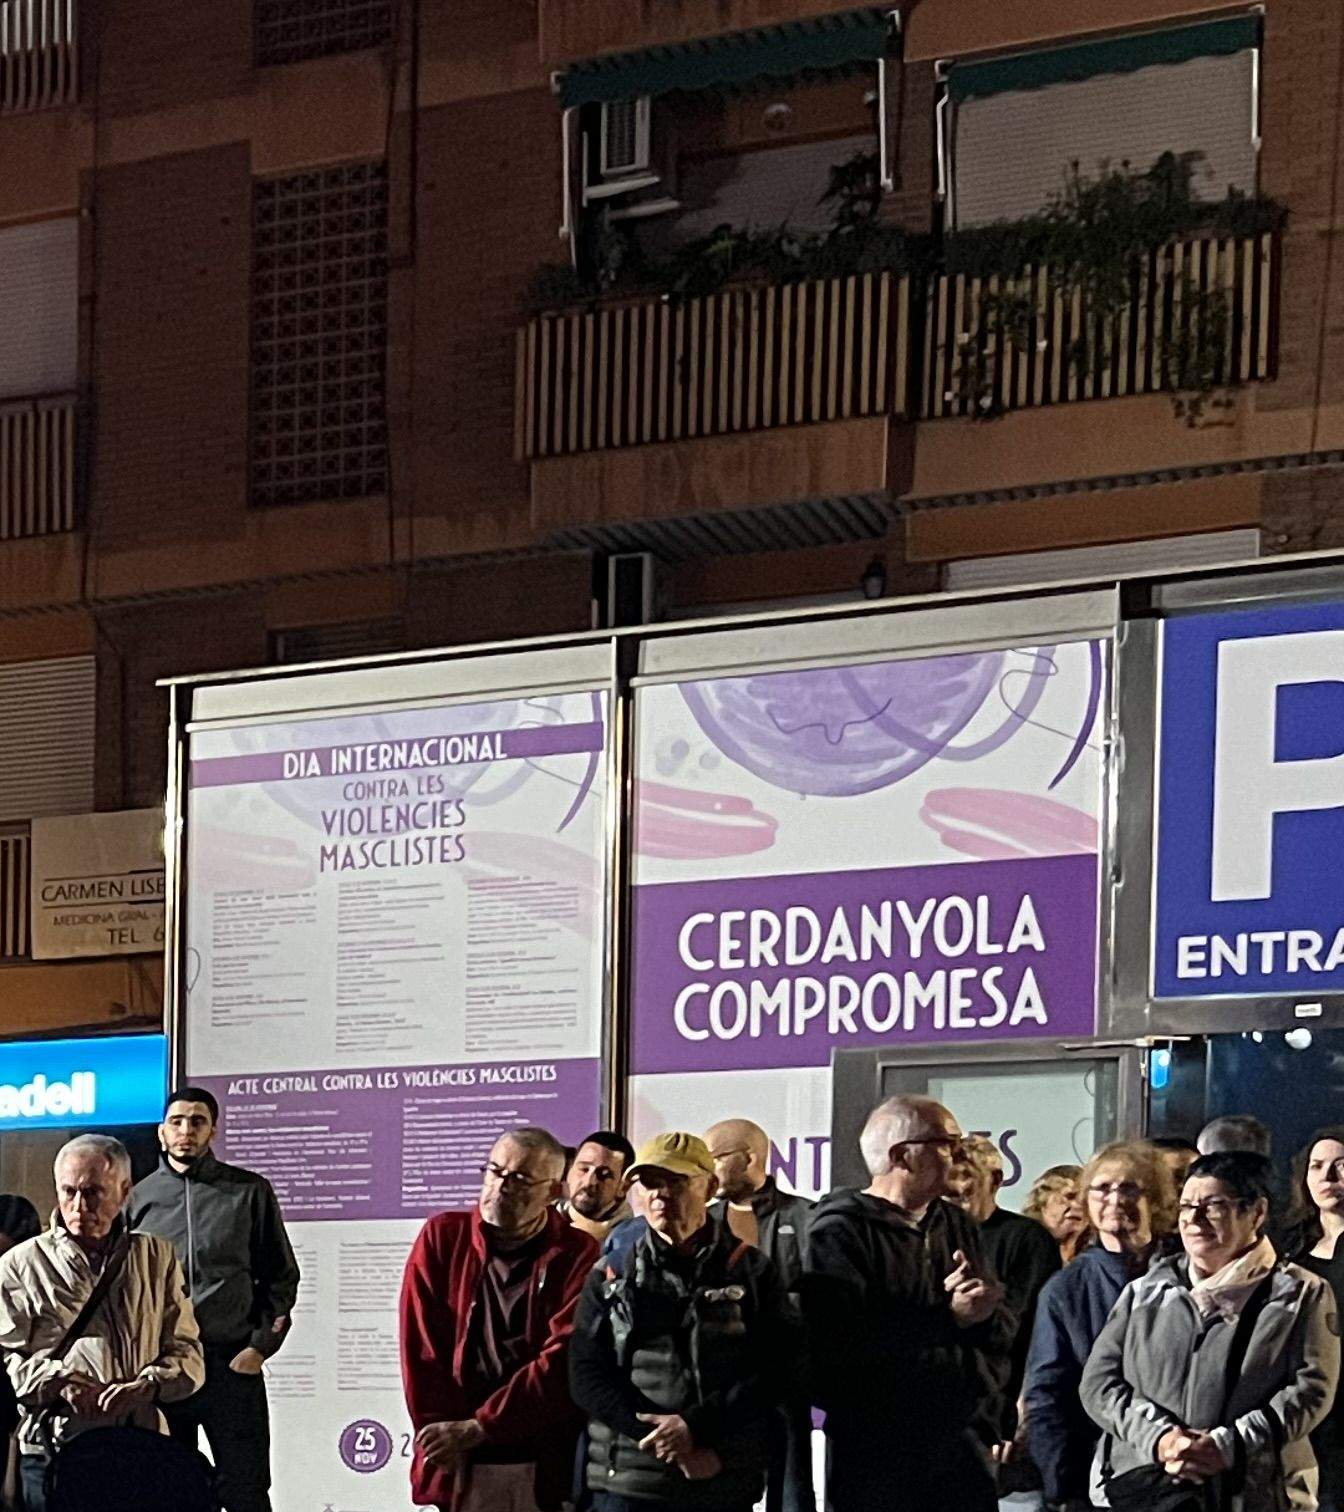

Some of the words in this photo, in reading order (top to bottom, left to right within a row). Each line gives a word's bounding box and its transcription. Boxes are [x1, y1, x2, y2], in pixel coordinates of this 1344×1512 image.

[283, 751, 321, 778] DIA
[331, 733, 507, 775] INTERNACIONAL
[1211, 630, 1344, 902] P
[343, 779, 409, 801] CONTRA
[417, 774, 445, 796] LES
[320, 833, 466, 873] MASCLISTES
[41, 881, 124, 902] CARMEN
[678, 894, 1045, 972] CERDANYOLA
[674, 966, 1048, 1042] COMPROMESA
[227, 1078, 259, 1096] ACTE
[262, 1075, 318, 1094] CENTRAL
[322, 1073, 373, 1091] CONTRA
[376, 1071, 399, 1089] LES
[479, 1064, 558, 1084] MASCLISTES
[355, 1427, 376, 1451] 25
[354, 1452, 378, 1465] NOV
